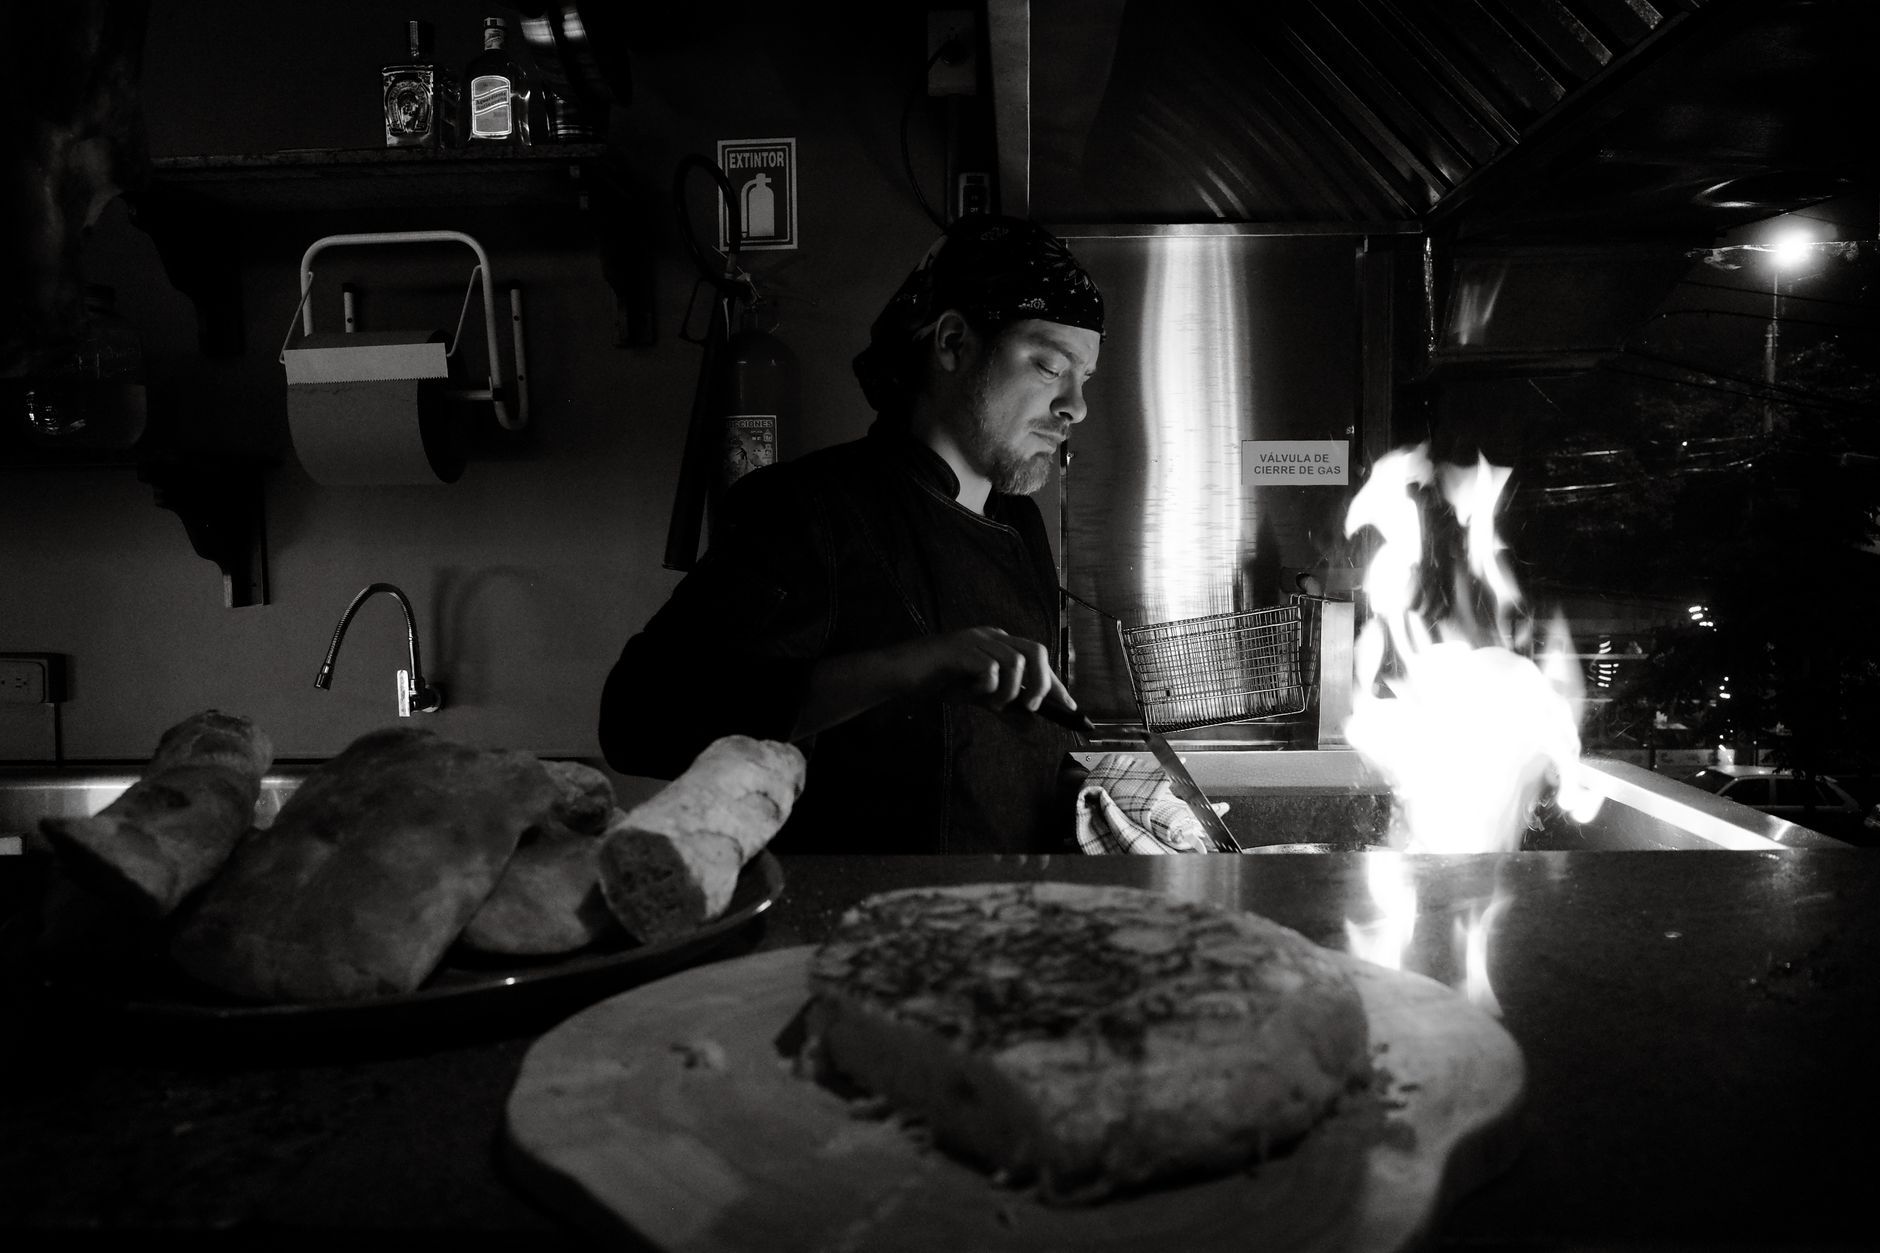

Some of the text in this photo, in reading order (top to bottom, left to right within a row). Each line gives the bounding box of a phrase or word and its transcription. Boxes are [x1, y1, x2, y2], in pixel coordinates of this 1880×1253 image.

[729, 151, 785, 169] EXTINTOR
[1260, 452, 1329, 463] VÁLVULA DE
[1254, 466, 1341, 475] CIERRE DE GAS
